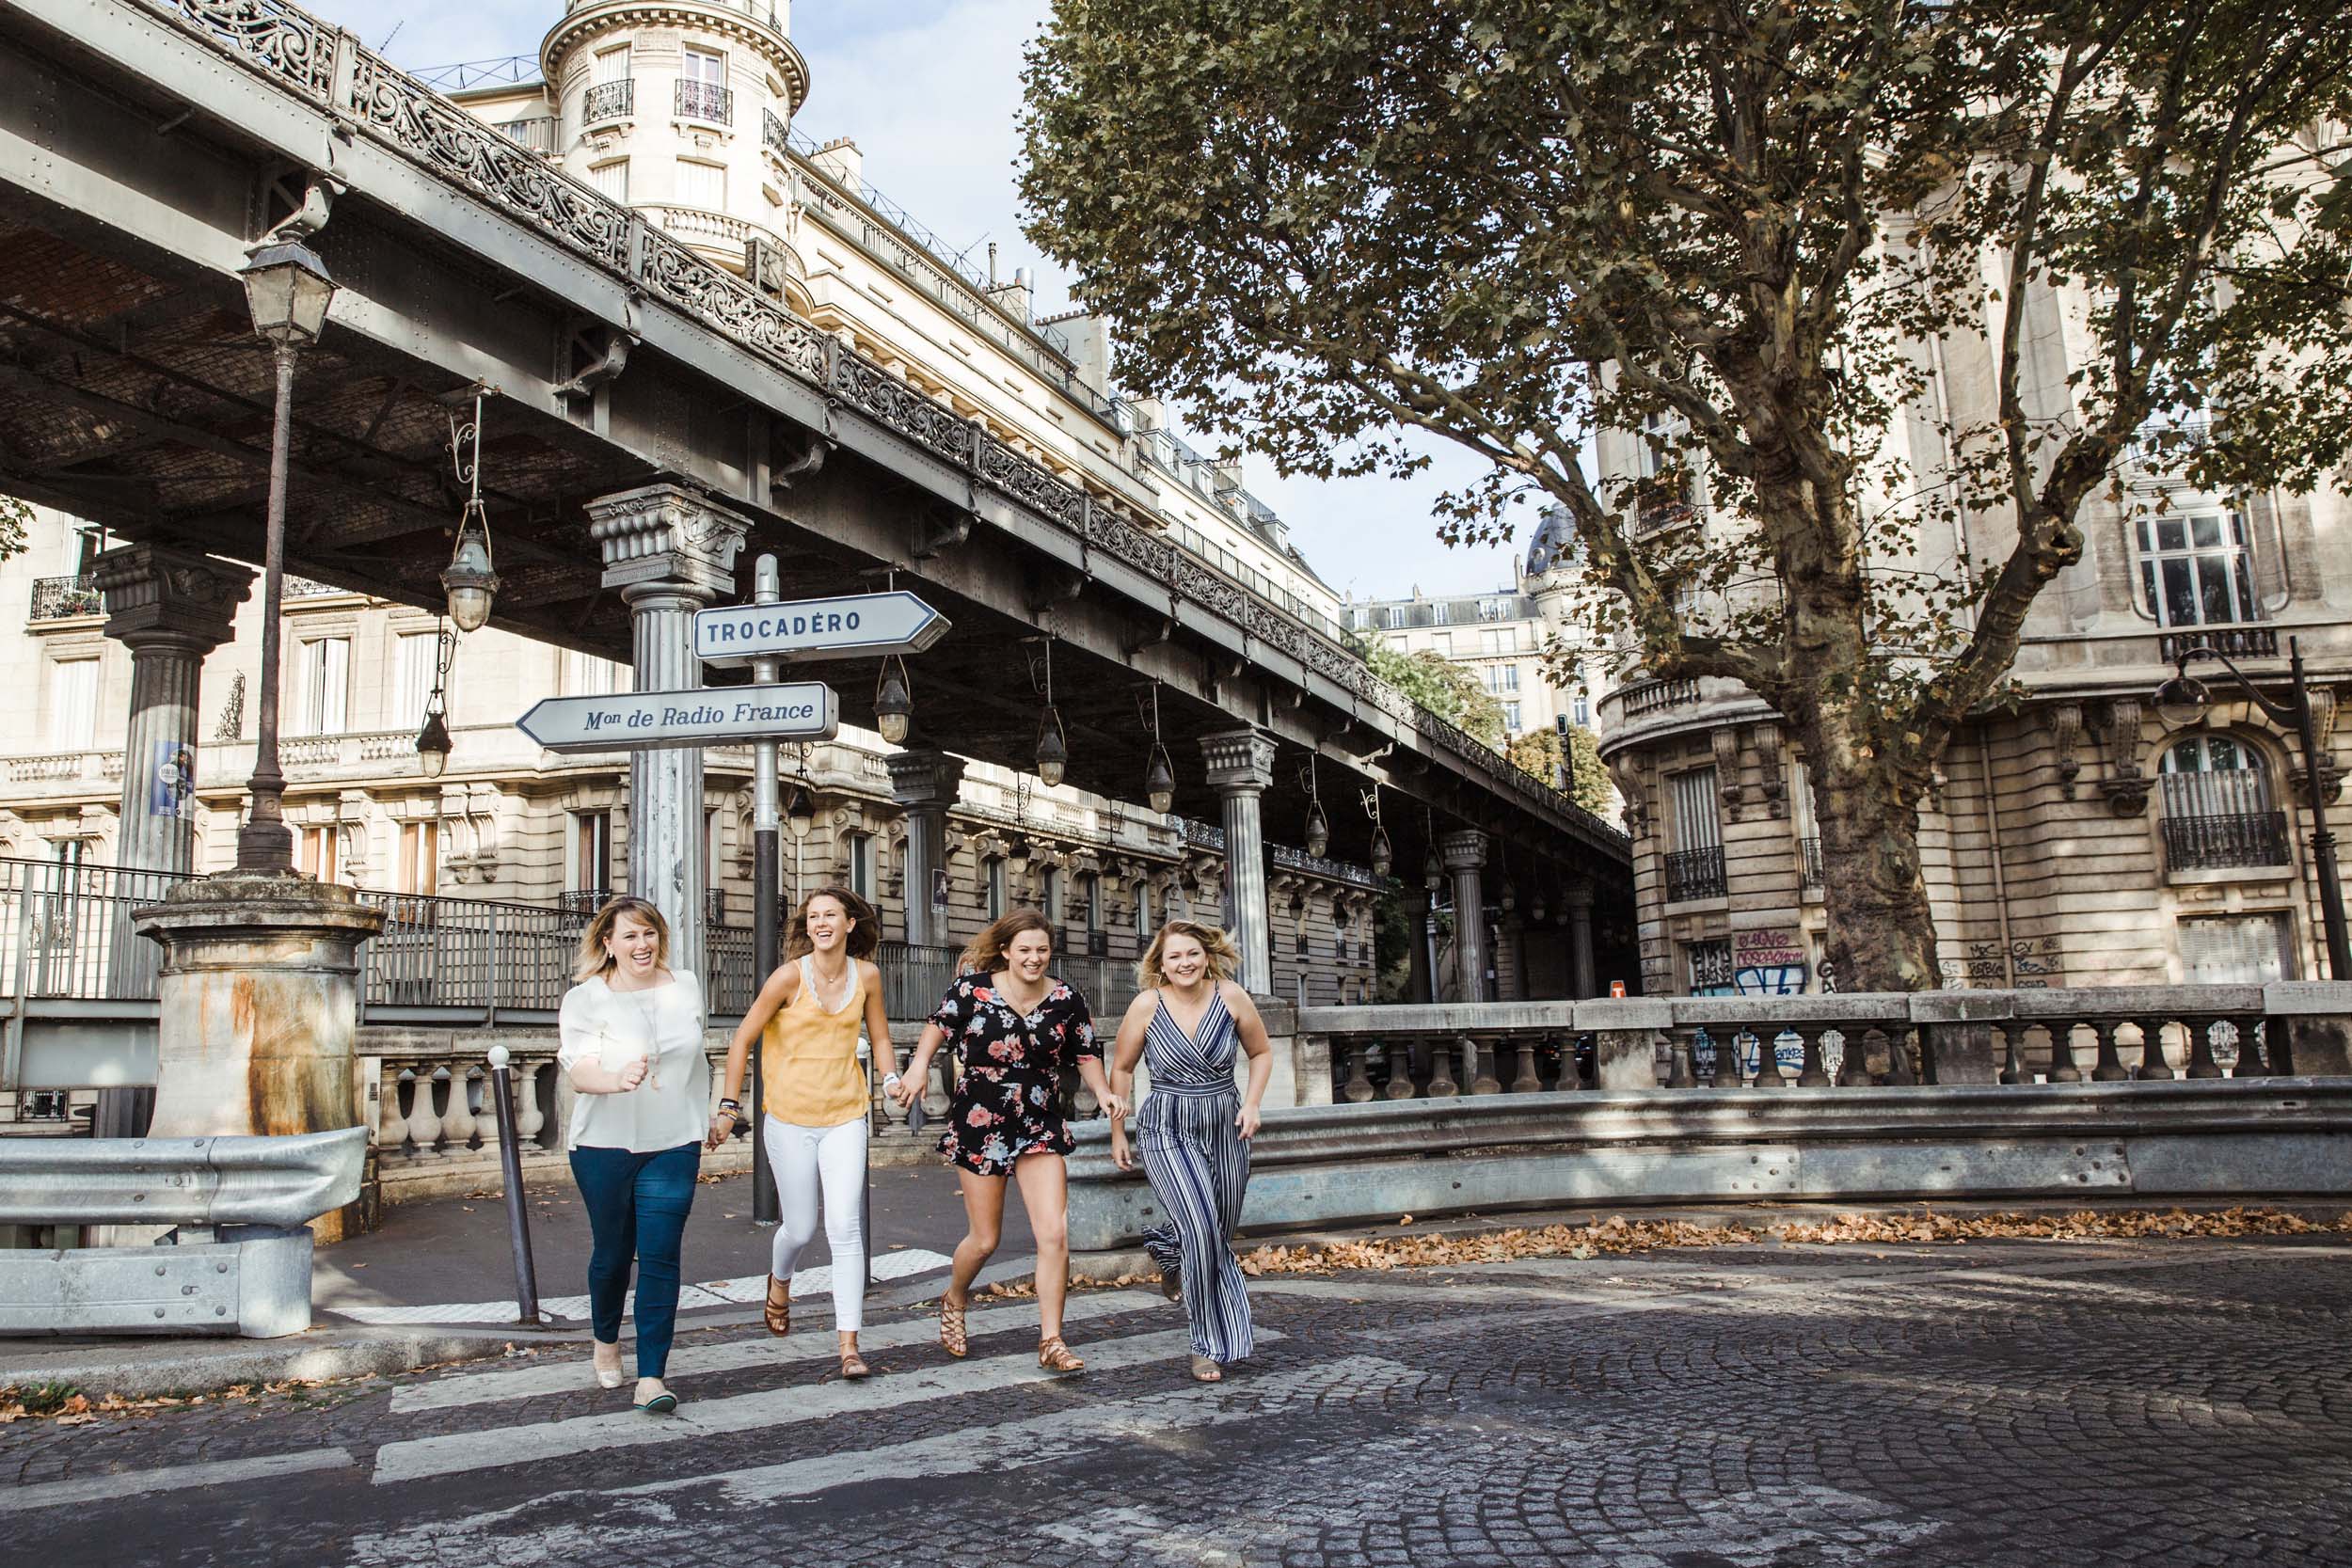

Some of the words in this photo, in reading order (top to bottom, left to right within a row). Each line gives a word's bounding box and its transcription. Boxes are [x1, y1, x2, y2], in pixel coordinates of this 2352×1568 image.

[707, 611, 860, 641] TROCADÉRO
[628, 709, 654, 727] de
[660, 705, 724, 726] Radio
[732, 703, 814, 722] France
